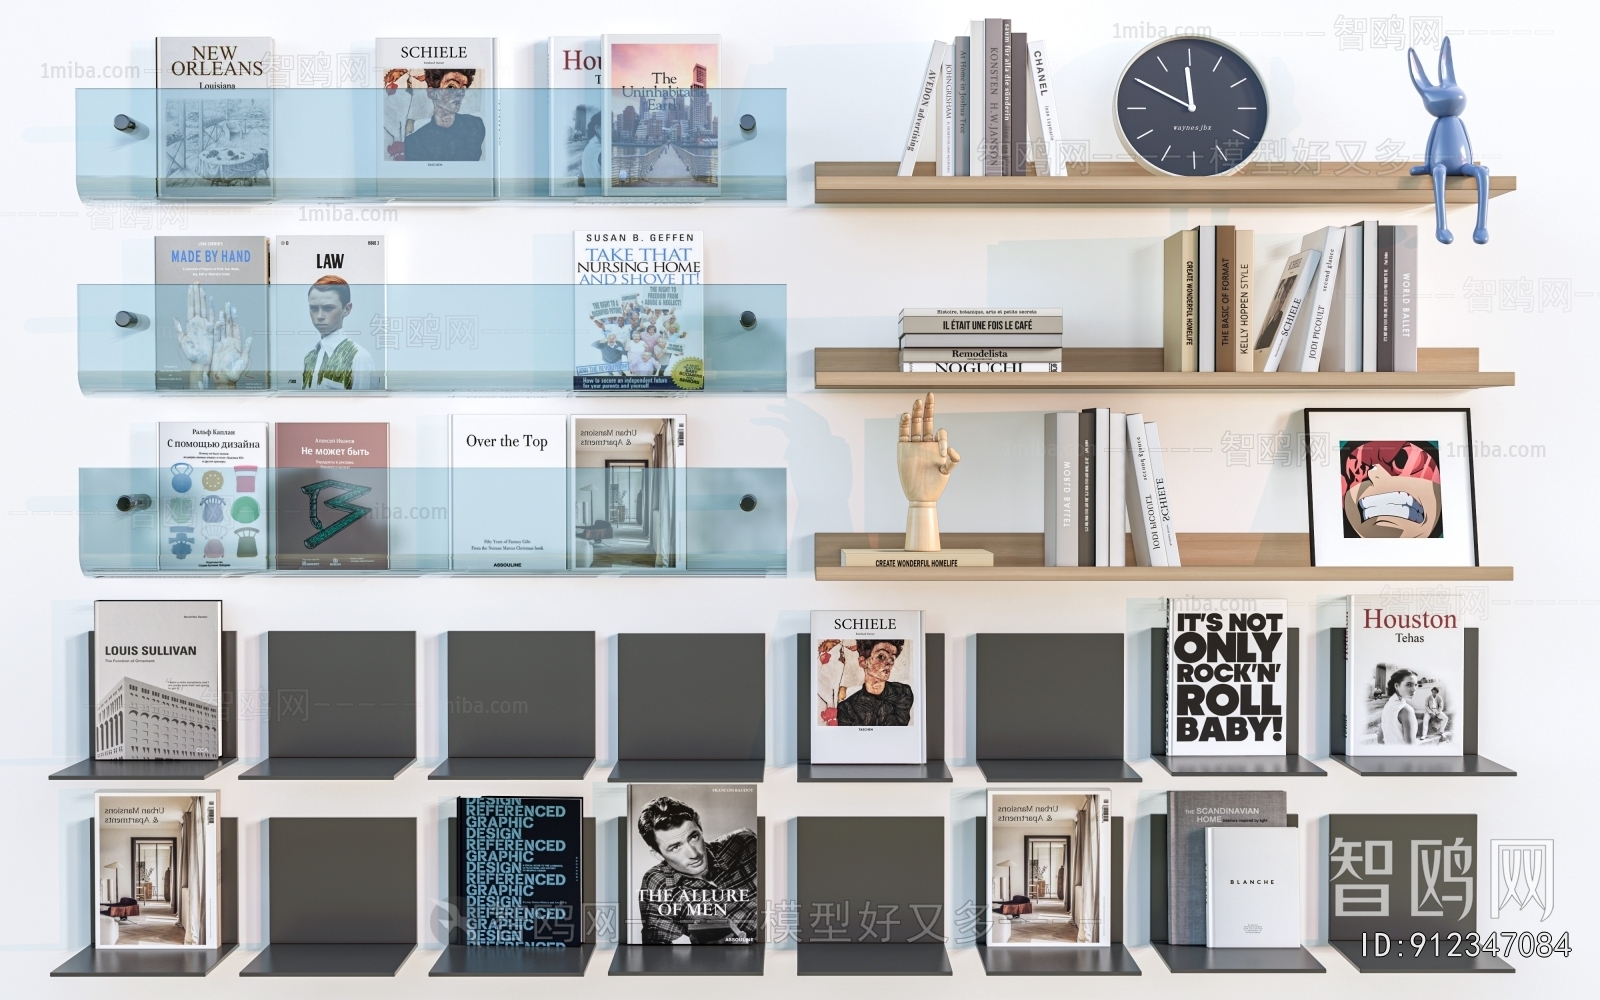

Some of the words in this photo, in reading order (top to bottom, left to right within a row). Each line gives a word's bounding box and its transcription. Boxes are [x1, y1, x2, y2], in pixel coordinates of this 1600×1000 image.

[192, 46, 238, 60] NEW
[401, 46, 467, 59] SCHIELE
[171, 61, 263, 76] ORLEANS
[990, 48, 998, 95] KONSTEN
[1034, 51, 1048, 96] CHANEL
[651, 72, 677, 84] The
[200, 82, 235, 90] Louisiana
[622, 86, 707, 97] Uninhabitable
[922, 70, 936, 107] AVEDON
[960, 82, 966, 90] in
[648, 99, 681, 111] Earth
[907, 108, 925, 152] advertising
[586, 234, 626, 242] SUSAN
[633, 234, 644, 242] B.
[650, 234, 694, 242] GEFFEN
[172, 250, 201, 262] MADE
[205, 250, 218, 262] BY
[222, 250, 251, 262] HAND
[586, 248, 633, 261] TAKE
[639, 248, 692, 261] THAT
[316, 254, 344, 269] LAW
[577, 262, 648, 273] NURSING
[654, 262, 700, 273] HOME
[580, 274, 616, 284] AND
[622, 274, 675, 284] SHOVE
[682, 273, 699, 284] IT!
[1240, 264, 1249, 289] STYLE
[1222, 293, 1229, 304] OF
[1240, 292, 1249, 329] HOPPEN
[1282, 298, 1302, 336] SCHIELE
[1313, 305, 1325, 340] PICOULT
[943, 321, 949, 330] IL
[951, 319, 970, 330] ÉTAIT
[972, 321, 986, 330] UNE
[988, 320, 1003, 330] FOIS
[1005, 321, 1013, 330] LE
[1015, 319, 1033, 330] CAFÉ
[1240, 330, 1249, 354] KELLY
[1309, 341, 1318, 359] JODI
[936, 363, 1022, 372] NOGUCHI
[167, 439, 173, 447] С
[175, 441, 220, 449] помощью
[221, 440, 260, 449] дизайна
[466, 435, 496, 448] Over
[500, 435, 520, 448] the
[523, 435, 548, 451] Top
[301, 447, 313, 455] Не
[348, 447, 369, 456] быть
[834, 619, 897, 630] SCHIELE
[1178, 613, 1223, 632] IT'S
[1229, 613, 1283, 632] NOT
[1363, 608, 1457, 629] Houston
[1395, 633, 1424, 643] Tehas
[105, 646, 138, 656] LOUIS
[142, 646, 196, 656] SULLIVAN
[1174, 632, 1283, 663] ONLY
[1177, 663, 1281, 683] ROCK'N'
[1177, 684, 1282, 716] ROLL
[1177, 717, 1283, 742] BABY!
[466, 805, 566, 817] REFERENCED
[466, 817, 534, 829] GRAPHIC
[466, 828, 521, 839] DESIGN
[466, 839, 566, 852] REFERENCED
[466, 850, 534, 862] GRAPHIC
[466, 862, 521, 873] DESIGN
[466, 874, 566, 885] REFERENCED
[466, 884, 534, 896] GRAPHIC
[636, 889, 673, 902] THE
[680, 889, 749, 902] ALLURE
[466, 896, 521, 907] DESIGN
[466, 907, 566, 919] REFERENCED
[658, 904, 681, 916] OF
[687, 904, 727, 916] MEN
[466, 919, 534, 930] GRAPHIC
[466, 930, 521, 942] DESIGN
